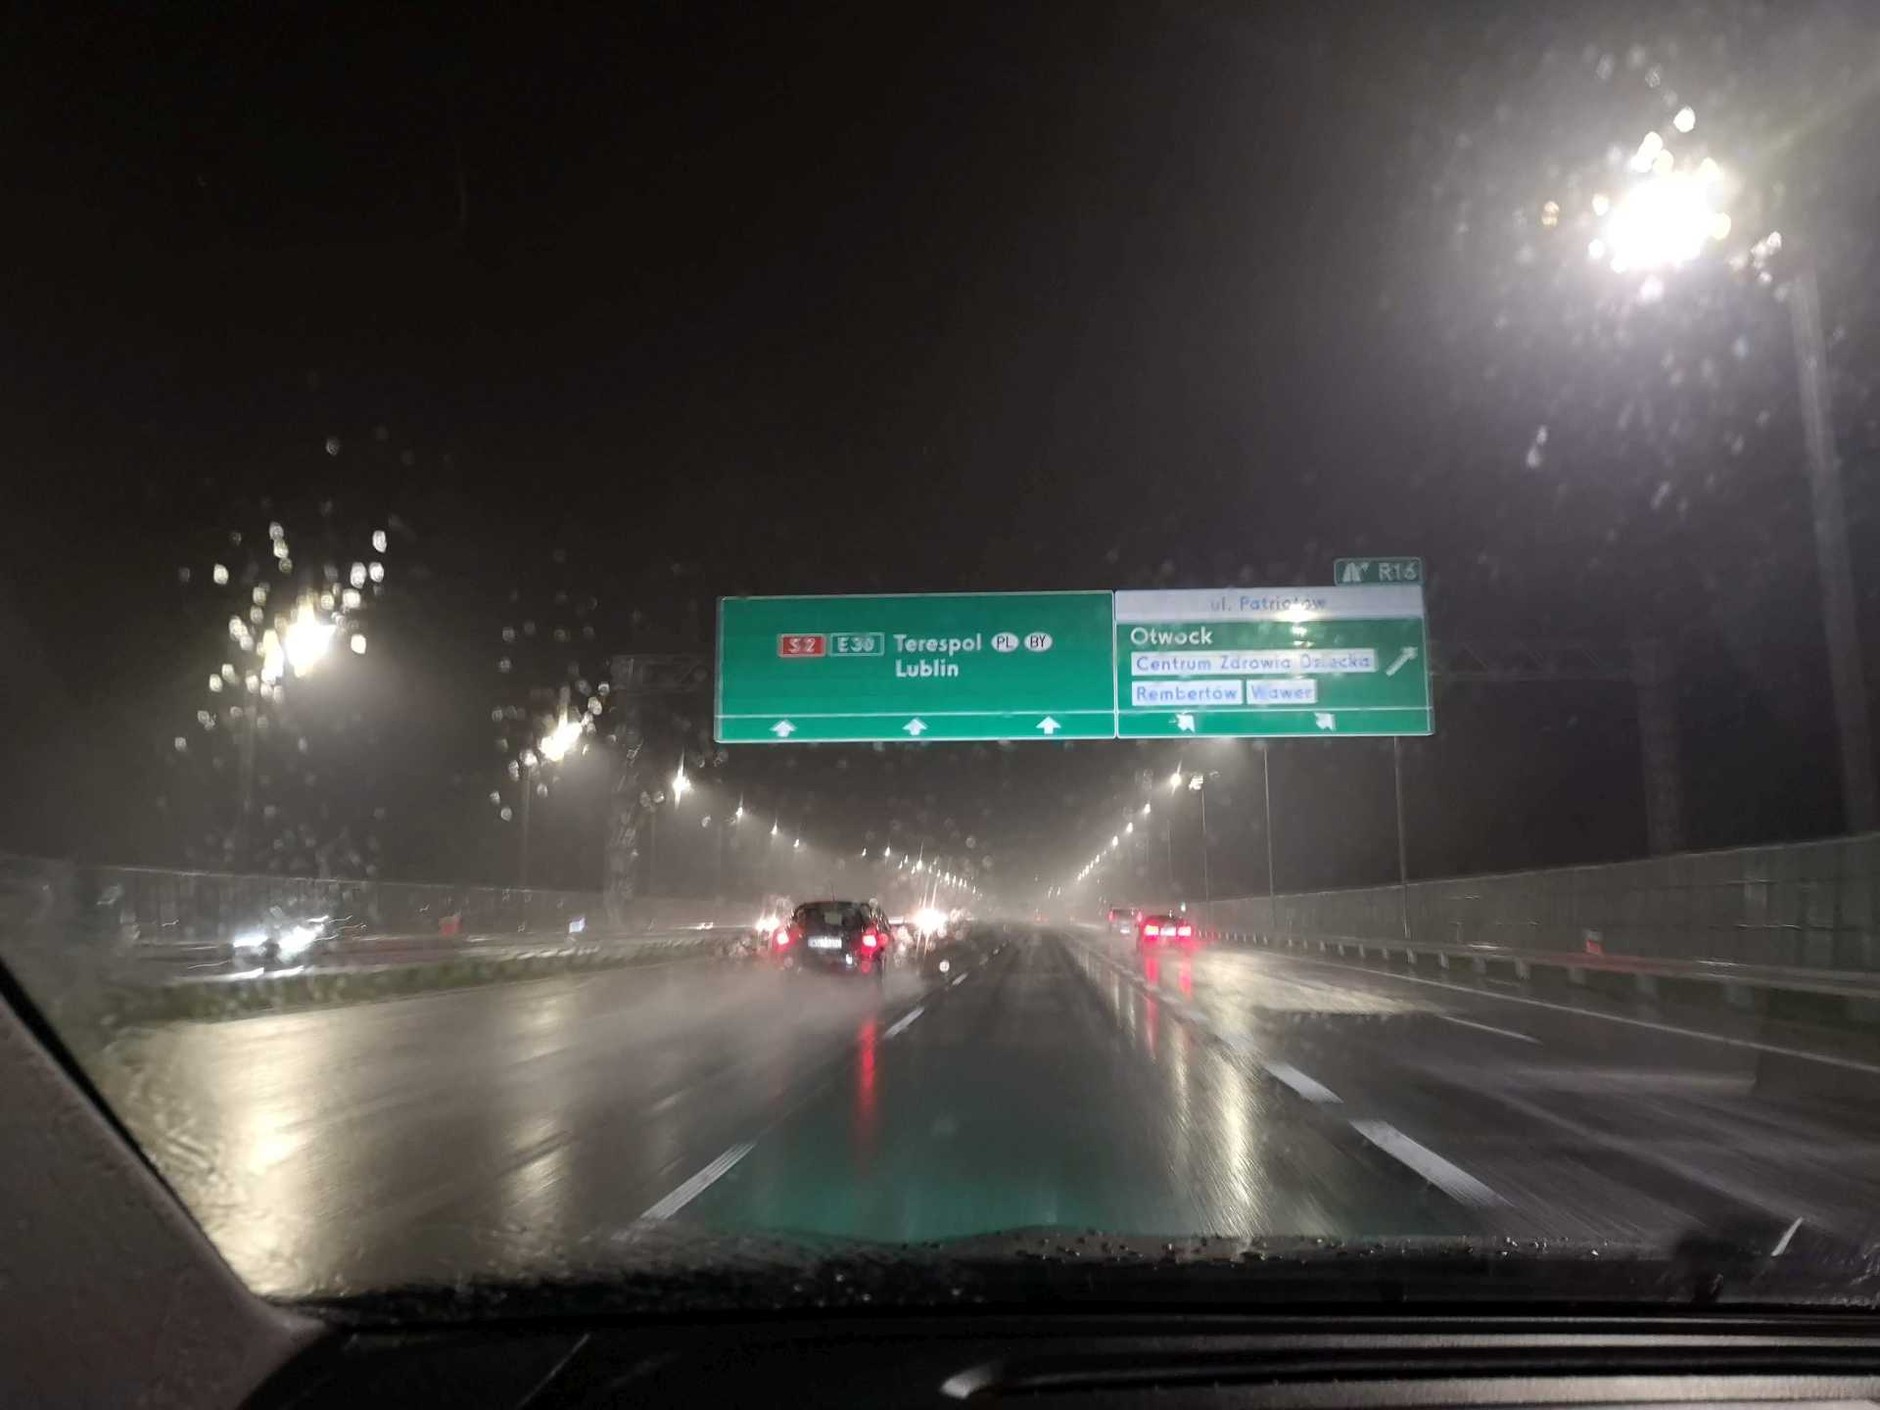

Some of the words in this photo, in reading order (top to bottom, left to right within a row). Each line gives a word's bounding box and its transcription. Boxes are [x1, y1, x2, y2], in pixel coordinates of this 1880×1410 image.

[1378, 562, 1417, 581] R16
[1210, 597, 1231, 611] ul.
[836, 636, 875, 653] E30
[893, 633, 982, 656] Terespol
[997, 635, 1013, 649] PL
[1030, 635, 1046, 648] BY
[1130, 626, 1213, 645] Otwock
[895, 659, 959, 678] Lublin
[1136, 656, 1211, 670] Centrum
[1219, 654, 1290, 670] Zdrowia
[1136, 685, 1238, 701] Rembertów
[1251, 684, 1314, 700] Wawer
